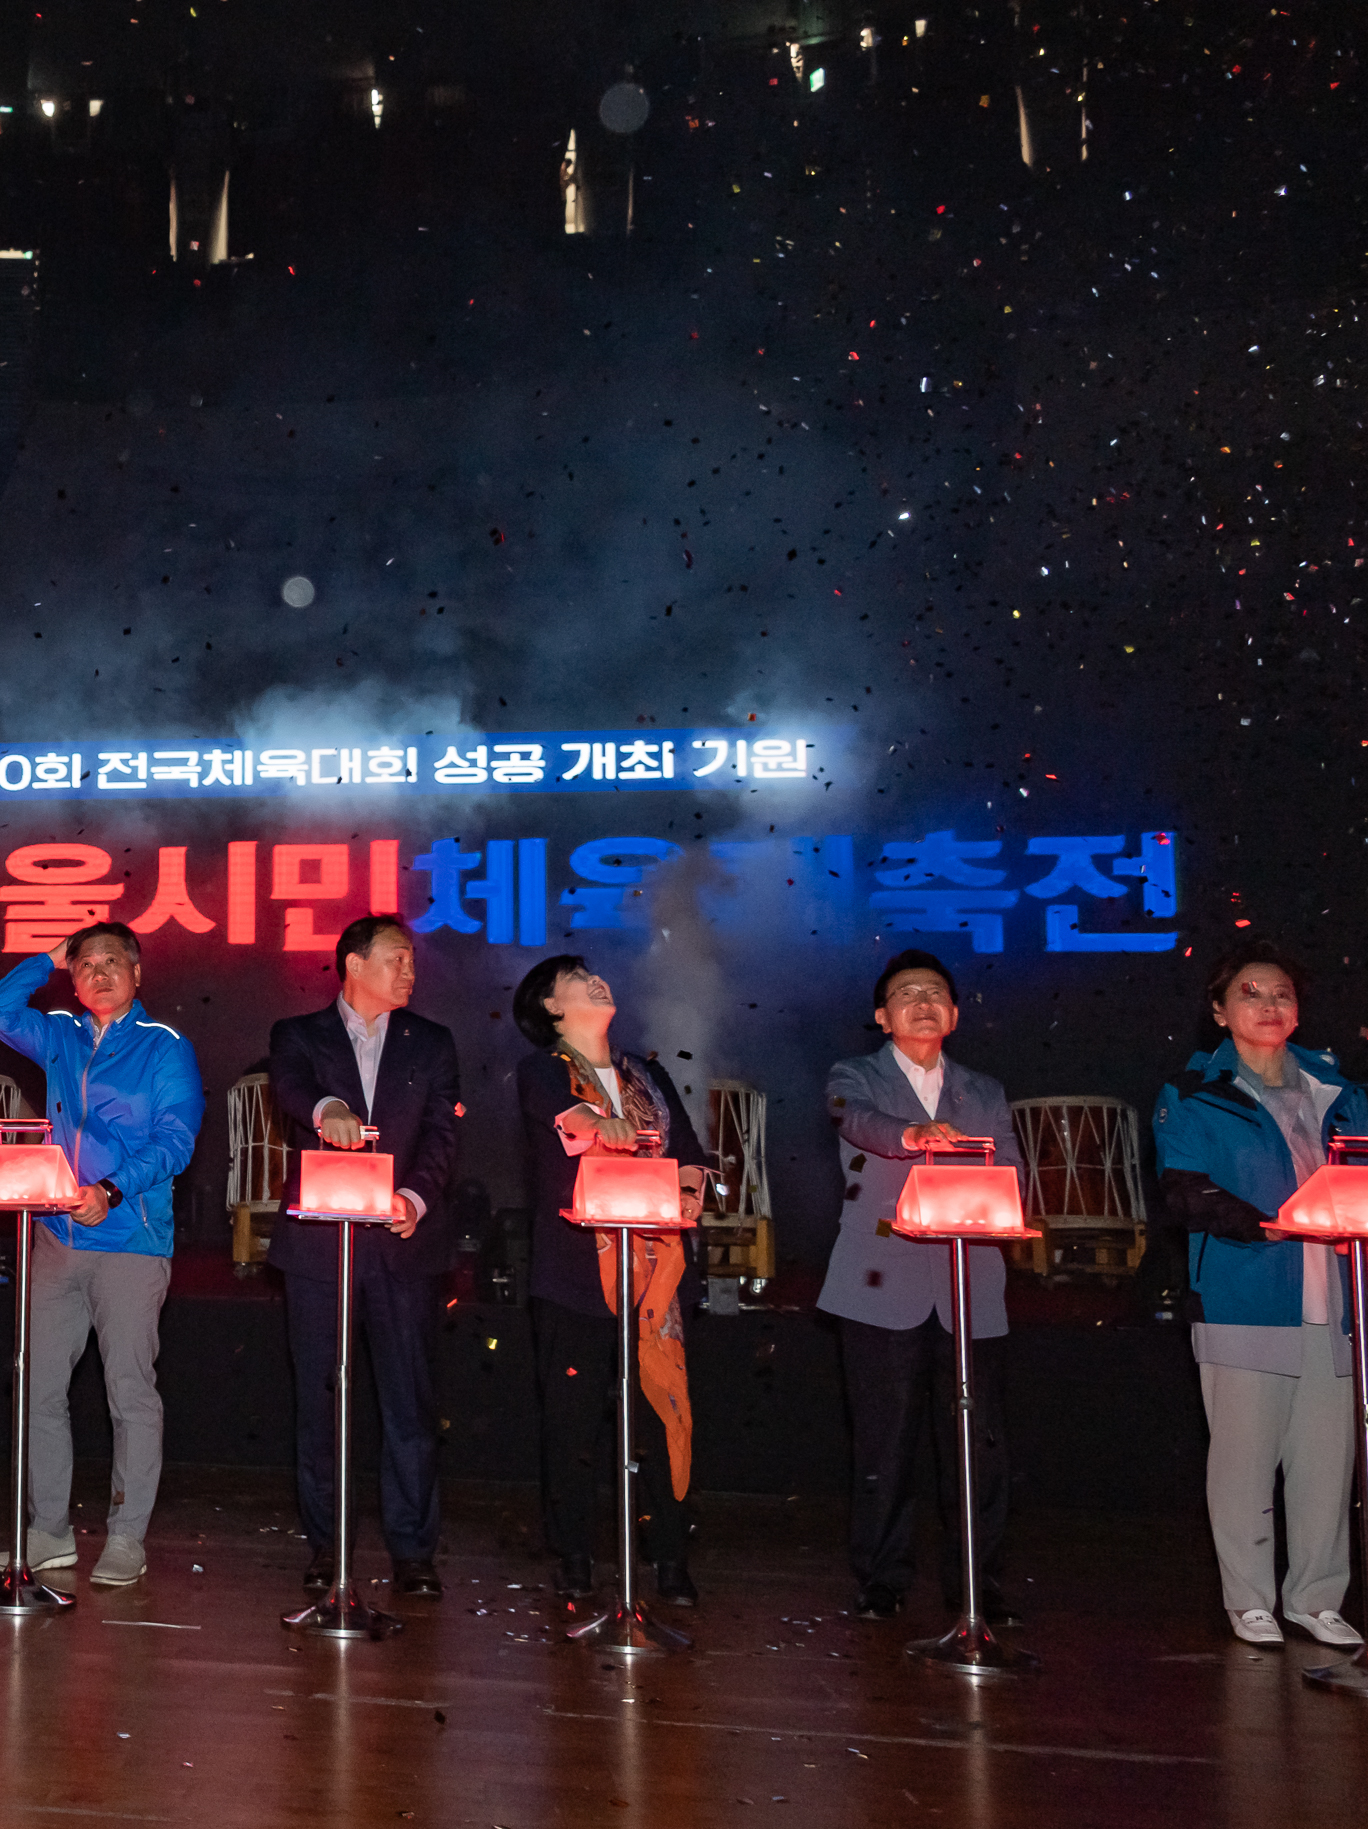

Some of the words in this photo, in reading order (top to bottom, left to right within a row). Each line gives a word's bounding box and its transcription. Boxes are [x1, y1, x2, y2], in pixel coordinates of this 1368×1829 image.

[96, 746, 419, 791] 전국체육대회
[433, 743, 547, 785] 성공
[561, 740, 675, 781] 개최
[692, 738, 809, 779] 기원
